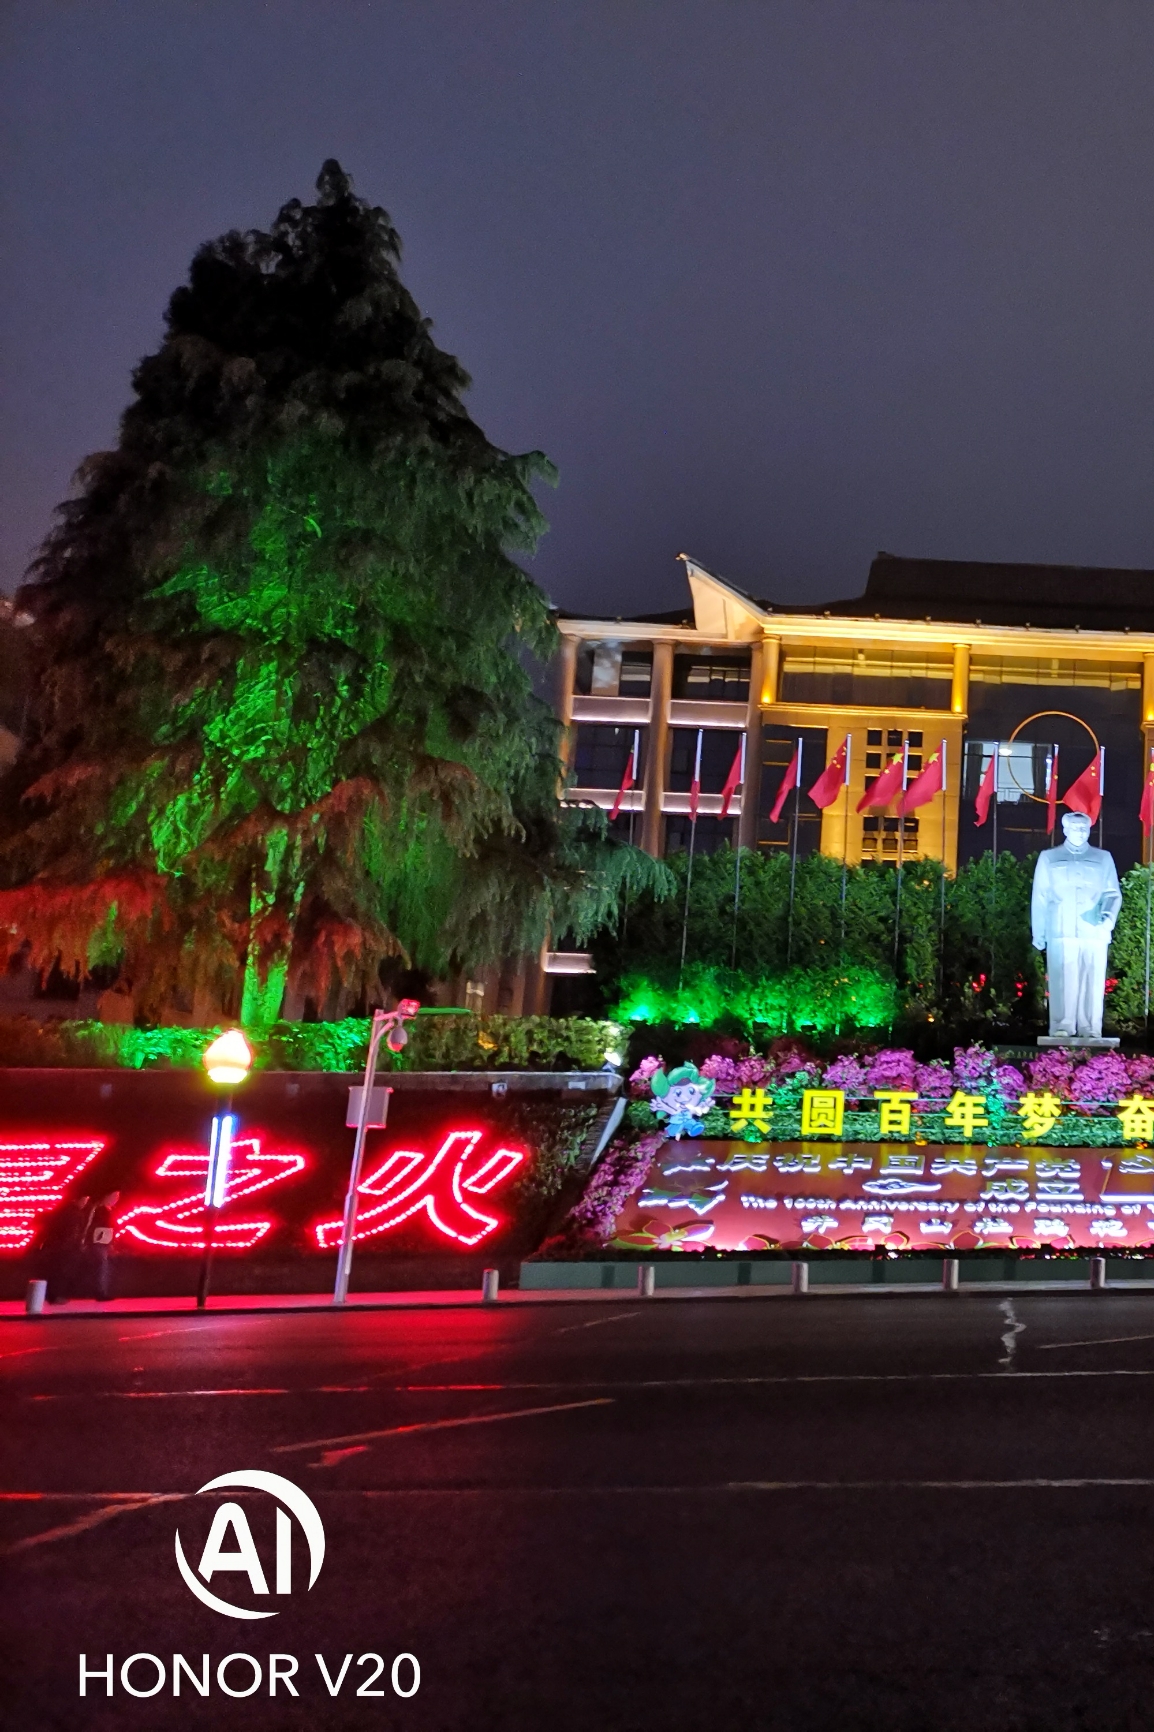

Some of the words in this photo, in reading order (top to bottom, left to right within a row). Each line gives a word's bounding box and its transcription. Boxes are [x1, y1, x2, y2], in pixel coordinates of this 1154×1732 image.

[729, 1088, 1062, 1138] 共圆百年梦
[715, 1152, 1082, 1178] 庆祝中国共产党
[979, 1178, 1085, 1201] 成立
